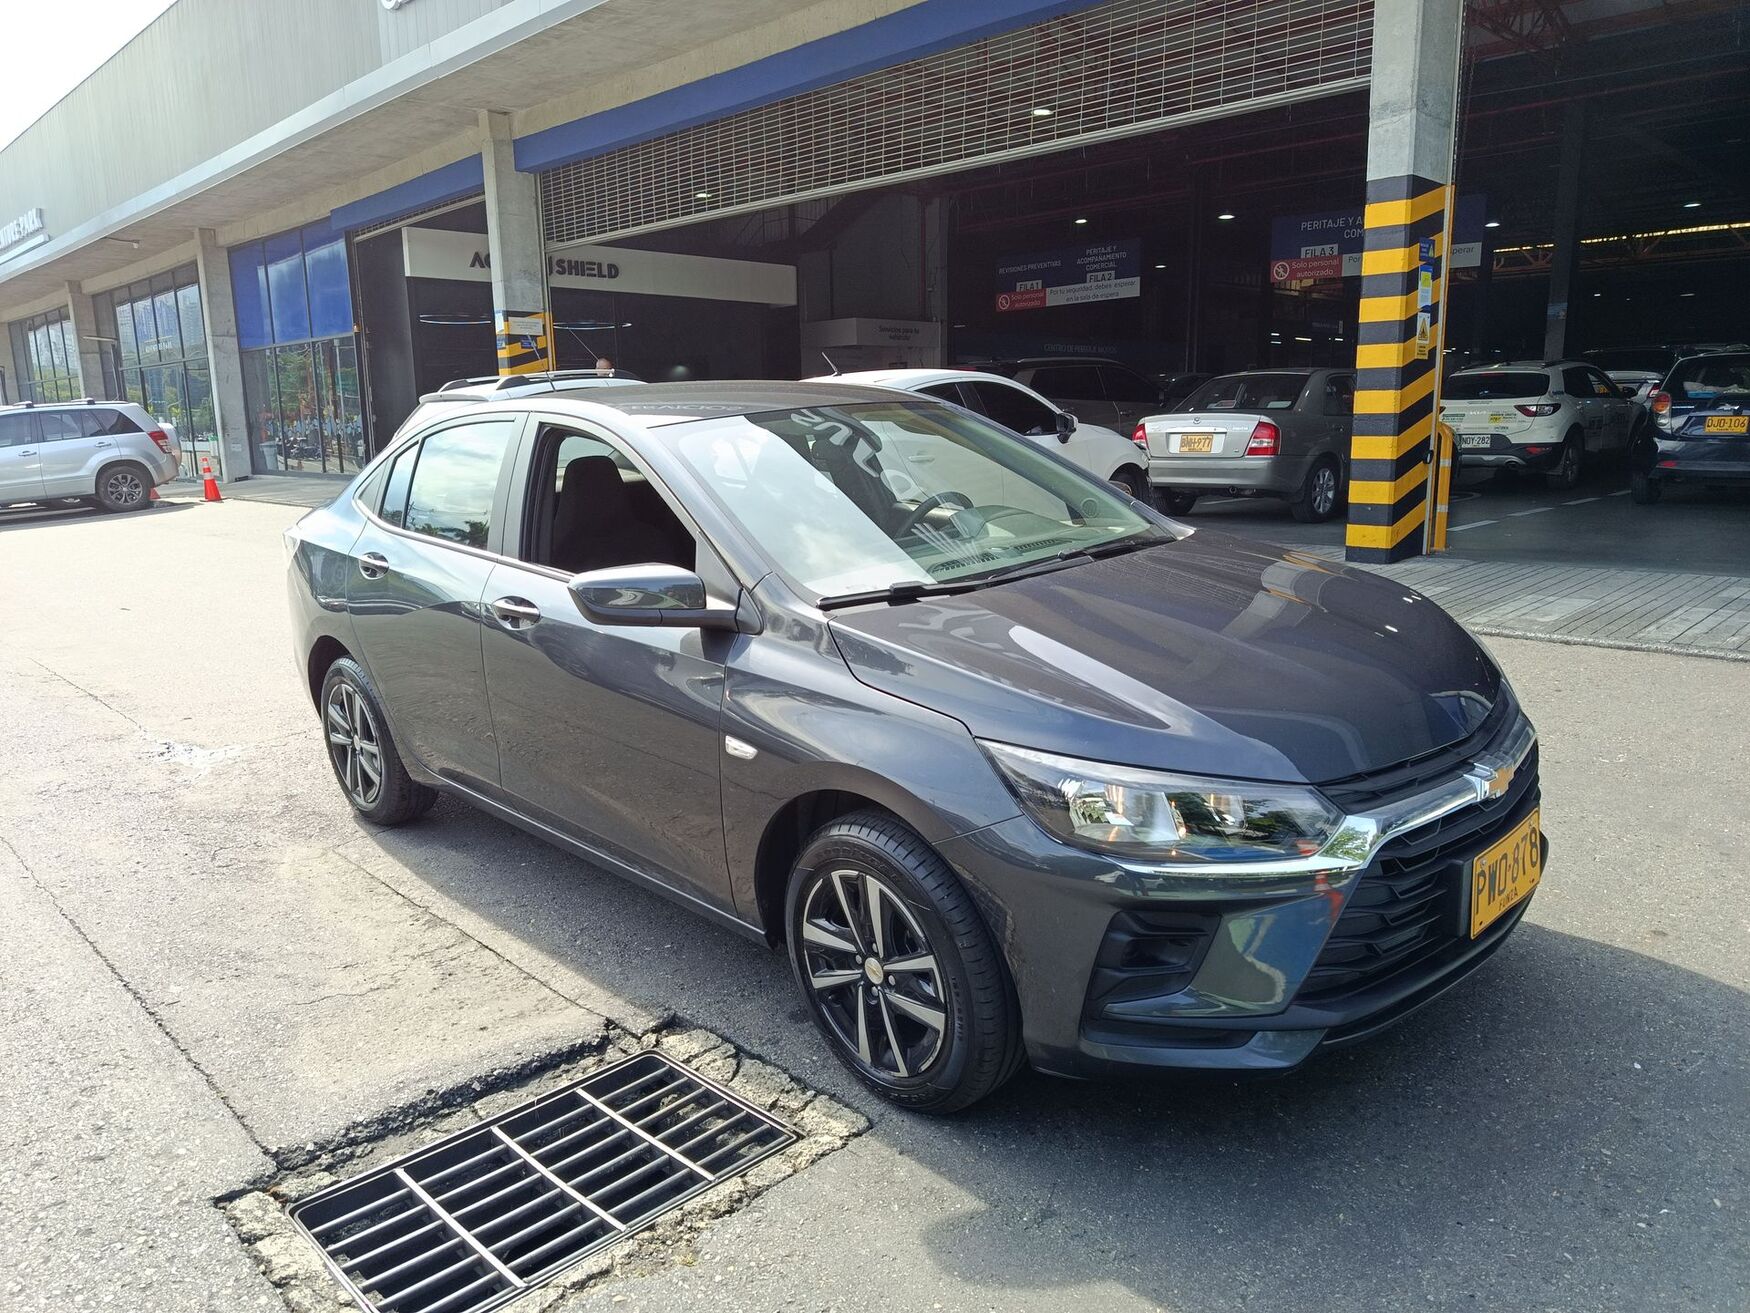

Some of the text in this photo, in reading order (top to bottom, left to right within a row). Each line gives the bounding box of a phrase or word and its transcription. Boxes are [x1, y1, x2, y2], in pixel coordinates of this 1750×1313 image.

[1301, 217, 1346, 231] PERITAJE
[1348, 216, 1354, 225] Y
[1085, 246, 1110, 256] PERITAJE
[1305, 248, 1326, 258] FILA
[1085, 261, 1117, 271] COMERCIAL
[1292, 257, 1340, 269] Solo personal
[1089, 273, 1106, 283] FILA
[1297, 268, 1334, 278] autorizado
[1498, 886, 1519, 911] FUNZA
